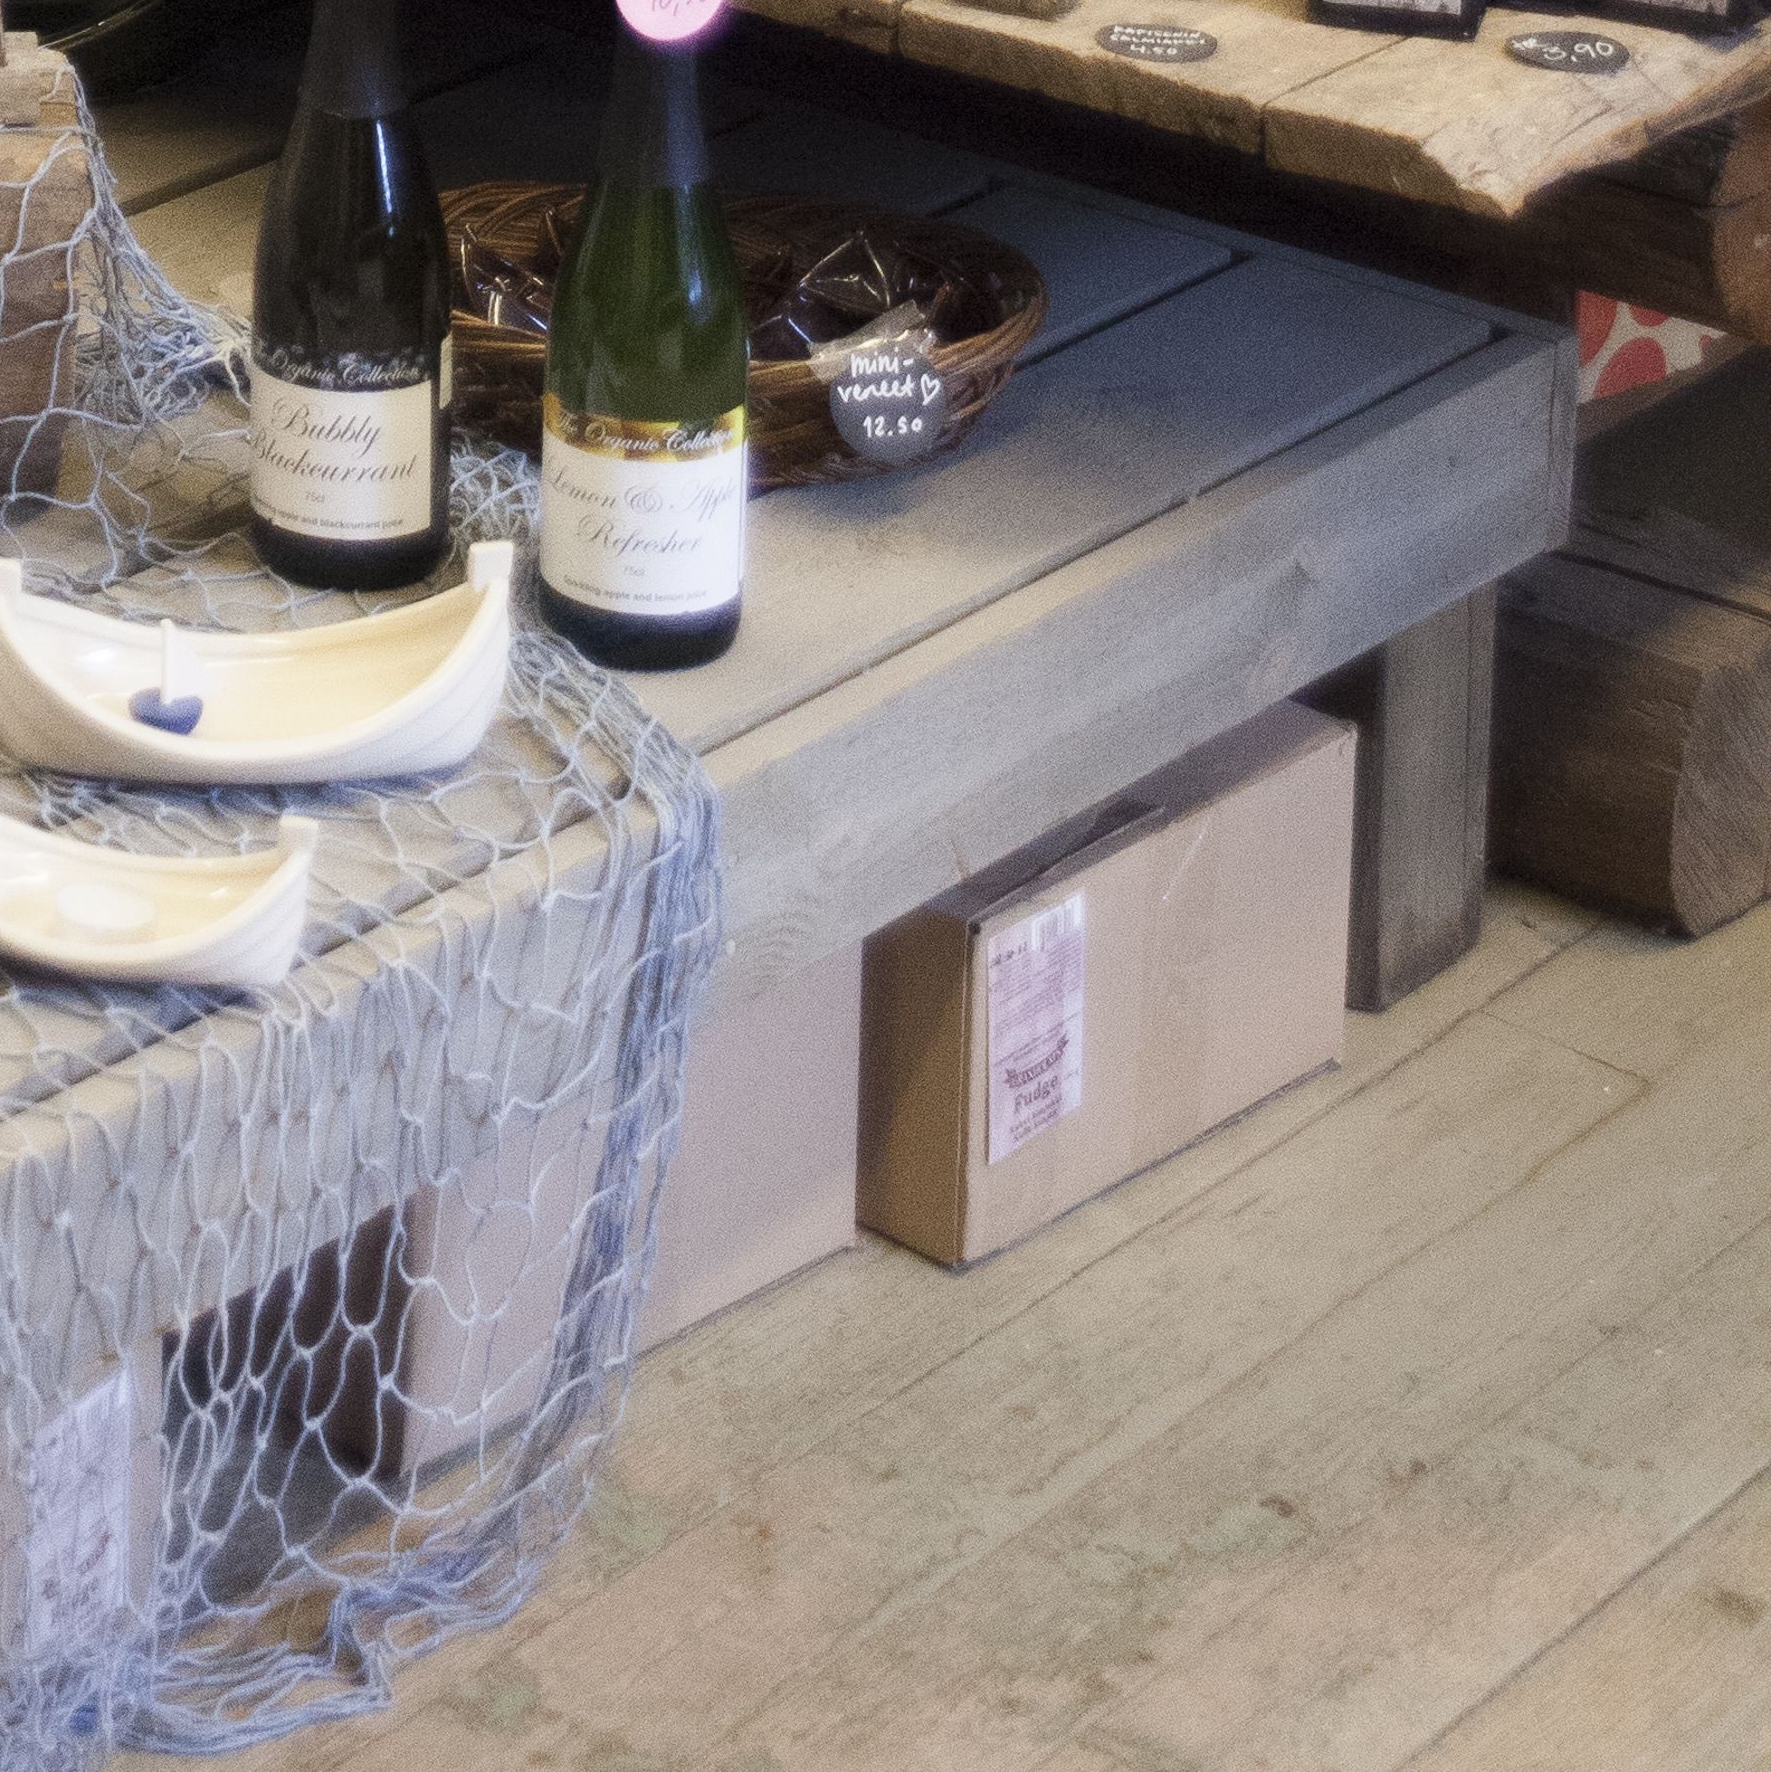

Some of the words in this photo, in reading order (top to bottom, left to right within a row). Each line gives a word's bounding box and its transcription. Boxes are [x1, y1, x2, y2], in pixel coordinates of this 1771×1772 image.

[1542, 40, 1615, 63] 3,90
[850, 345, 915, 378] mini-
[836, 374, 916, 403] veneet
[271, 397, 380, 458] Bubbly
[585, 421, 660, 452] Organic
[862, 415, 923, 438] 12.50
[245, 429, 417, 483] Blackcurrant
[547, 462, 617, 509] Lemon
[624, 481, 663, 513] &
[577, 514, 703, 558] Refresher
